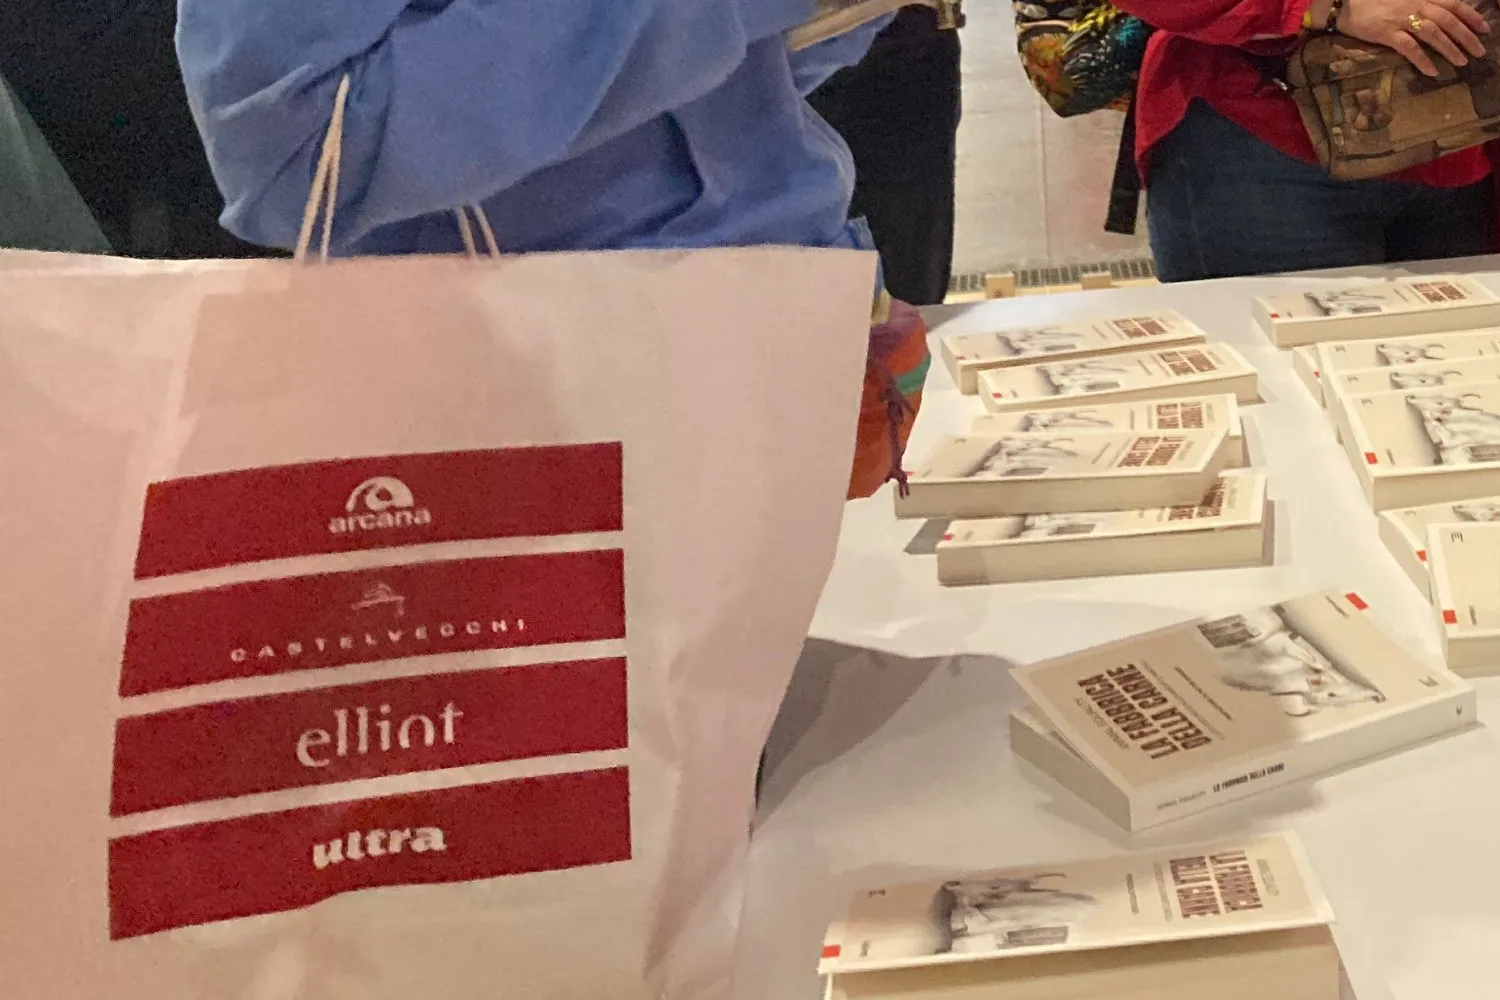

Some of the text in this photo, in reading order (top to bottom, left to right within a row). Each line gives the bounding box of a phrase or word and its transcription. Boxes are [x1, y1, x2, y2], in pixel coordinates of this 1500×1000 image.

[327, 505, 432, 535] arcana
[1077, 673, 1160, 742] FABBRICA
[1105, 663, 1169, 710] CARNE
[296, 701, 464, 768] elliot
[1140, 736, 1180, 760] LA
[1150, 705, 1213, 751] DELLA
[312, 826, 448, 870] ultra
